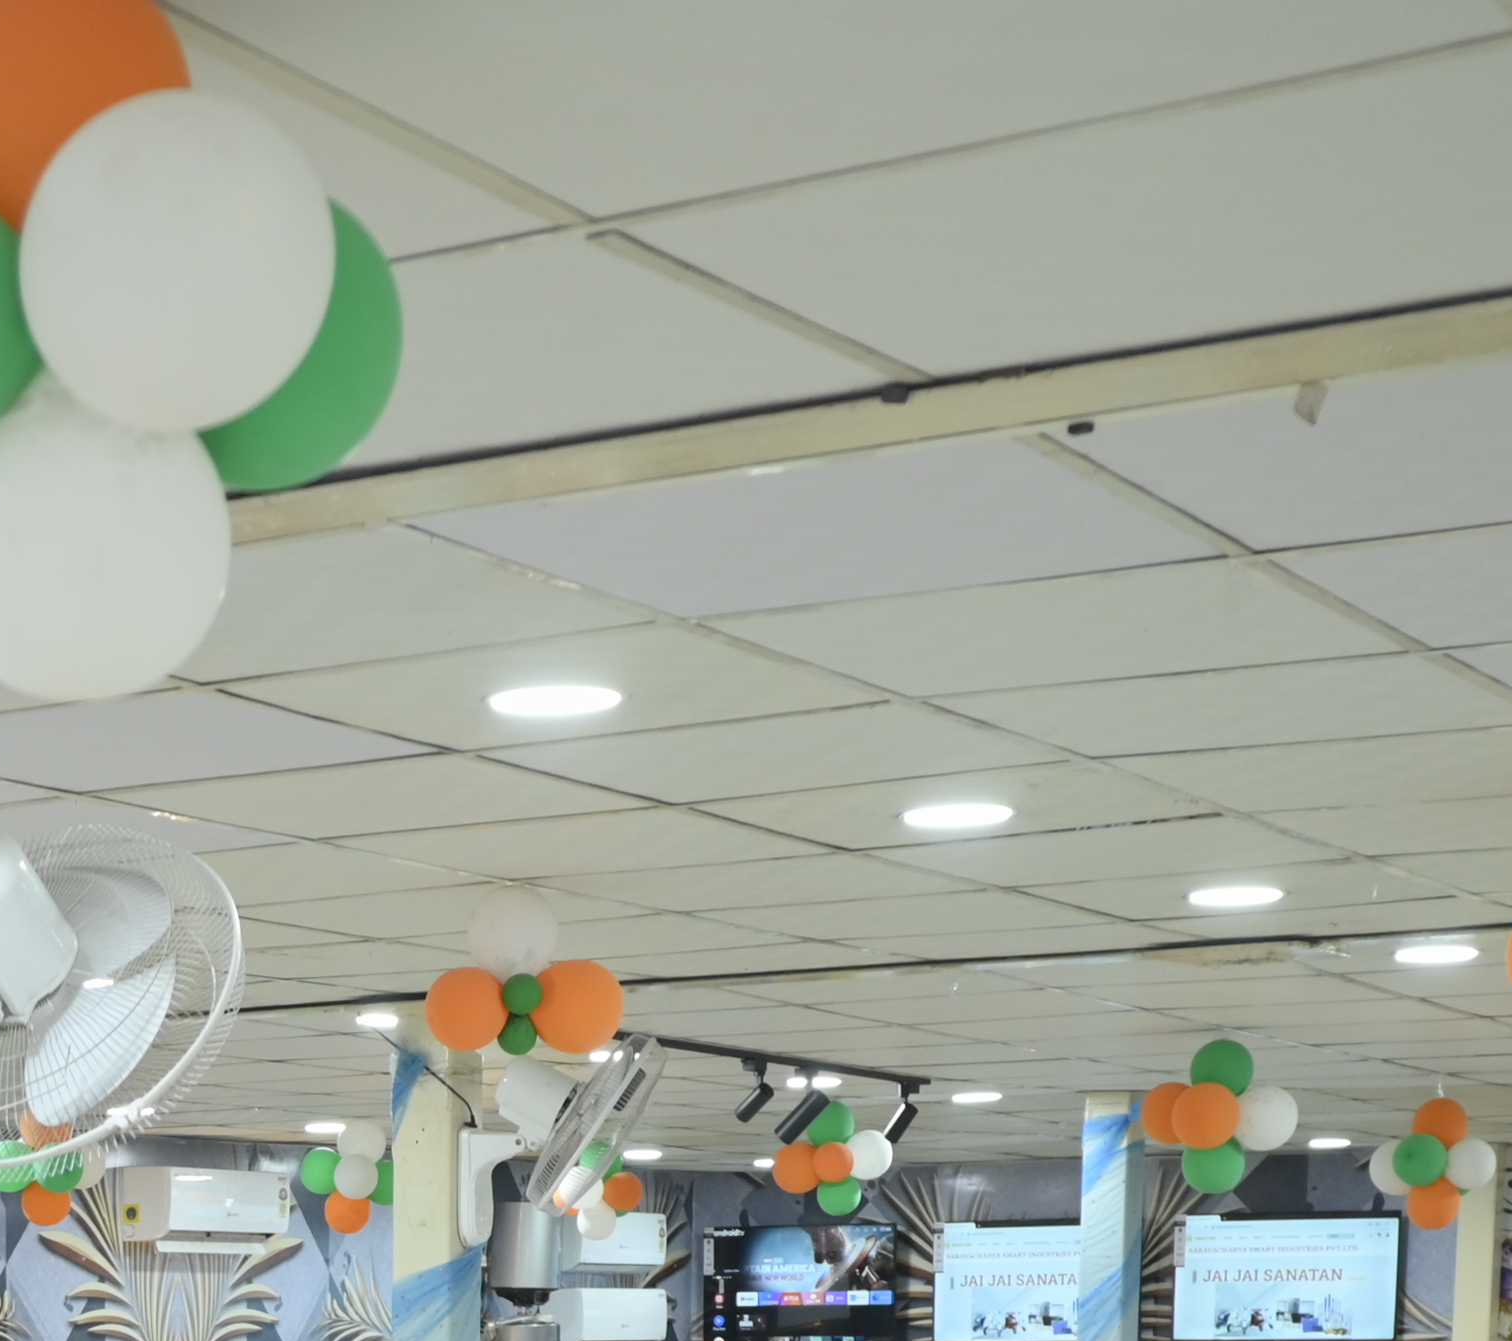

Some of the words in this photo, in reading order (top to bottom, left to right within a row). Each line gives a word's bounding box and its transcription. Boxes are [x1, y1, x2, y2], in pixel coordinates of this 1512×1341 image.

[772, 1263, 816, 1274] AMERICA
[1203, 1269, 1228, 1283] JAI
[1233, 1269, 1259, 1283] JAI
[1263, 1268, 1344, 1283] SANATAN
[960, 1275, 984, 1288] JAI
[988, 1274, 1012, 1287] JAI
[1016, 1273, 1078, 1287] SANATA
